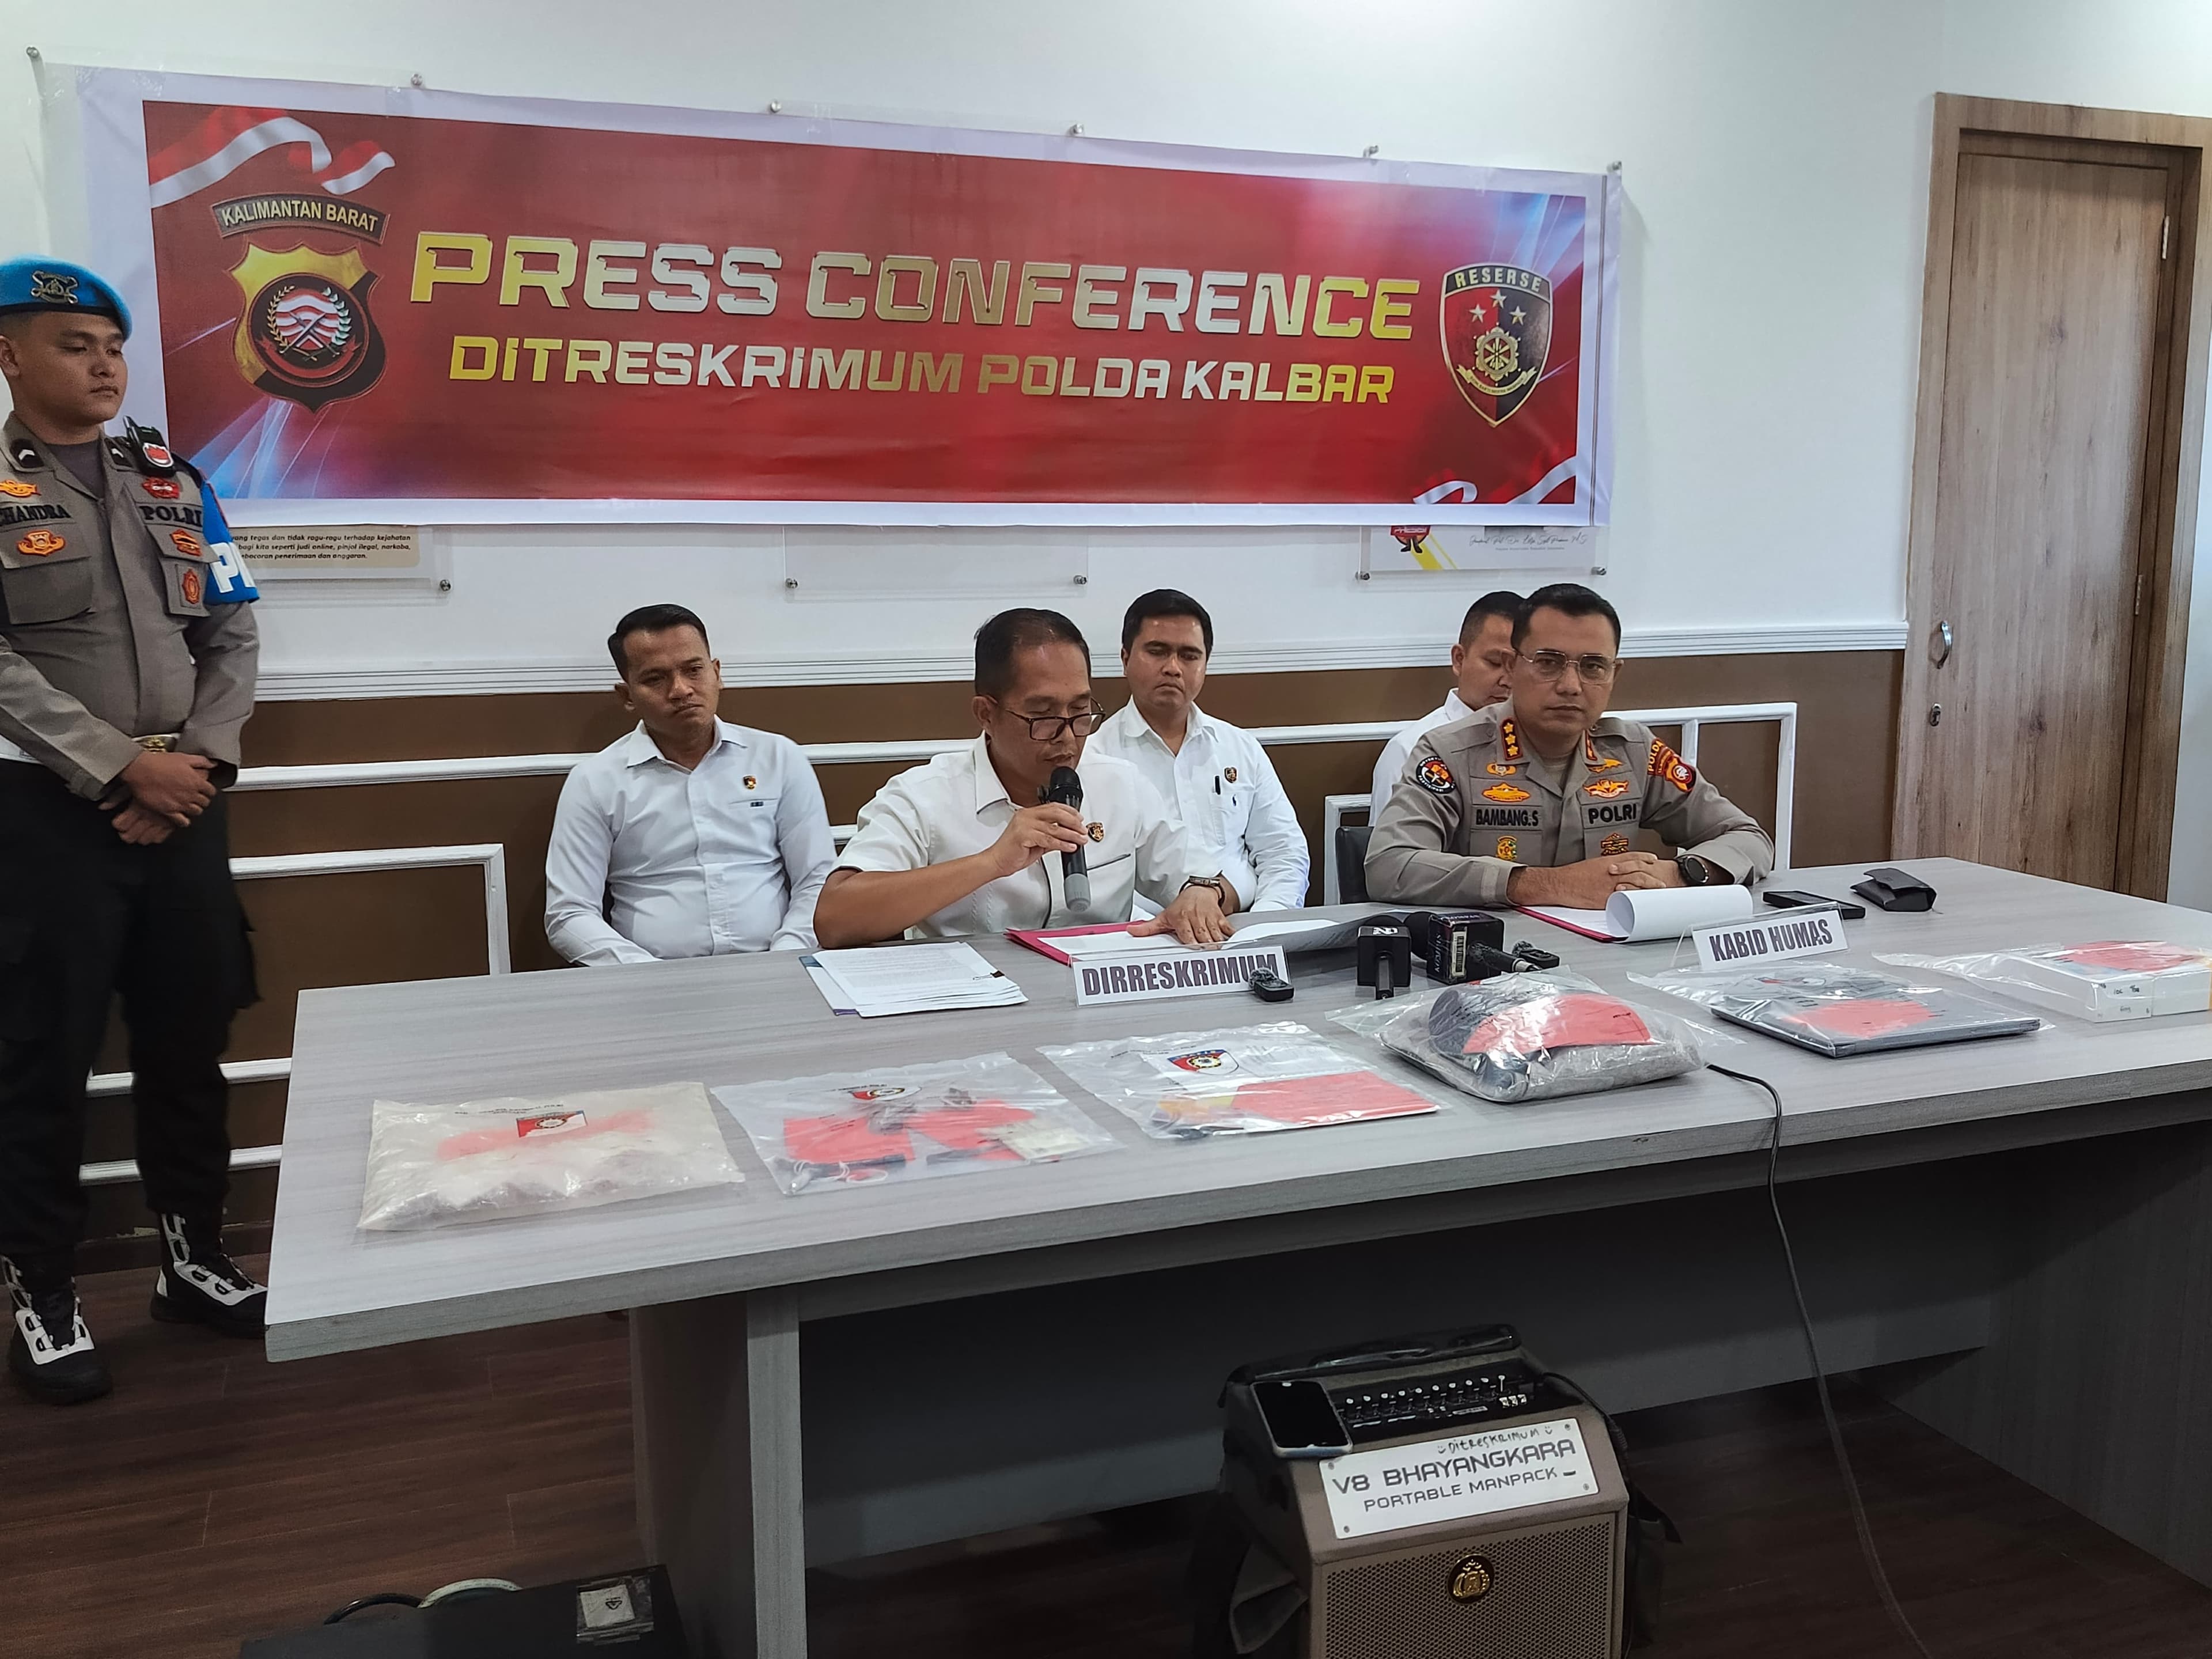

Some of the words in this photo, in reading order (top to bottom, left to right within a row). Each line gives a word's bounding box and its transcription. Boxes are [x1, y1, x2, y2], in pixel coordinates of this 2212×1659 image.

[221, 200, 322, 226] KALIMANTAN
[325, 203, 378, 232] BARAT
[410, 230, 782, 315] PRESS
[806, 251, 1420, 339] CONFERENCE
[1454, 266, 1543, 293] RESERSE
[449, 336, 964, 393] DITRESKRIMUM
[978, 354, 1171, 399] POLDA
[1181, 360, 1395, 403] KALBAR
[139, 506, 203, 527] POLRI
[1476, 809, 1539, 827] BAMBANG.S
[1588, 804, 1637, 824] POLRI
[1709, 929, 1768, 961] KABID
[1767, 919, 1833, 952] HUMAS
[1332, 1474, 1370, 1494] V8
[1382, 1439, 1576, 1486] BHAYANGKARA
[1363, 1484, 1463, 1512] PORTABLE
[1469, 1467, 1558, 1494] MANPACK
